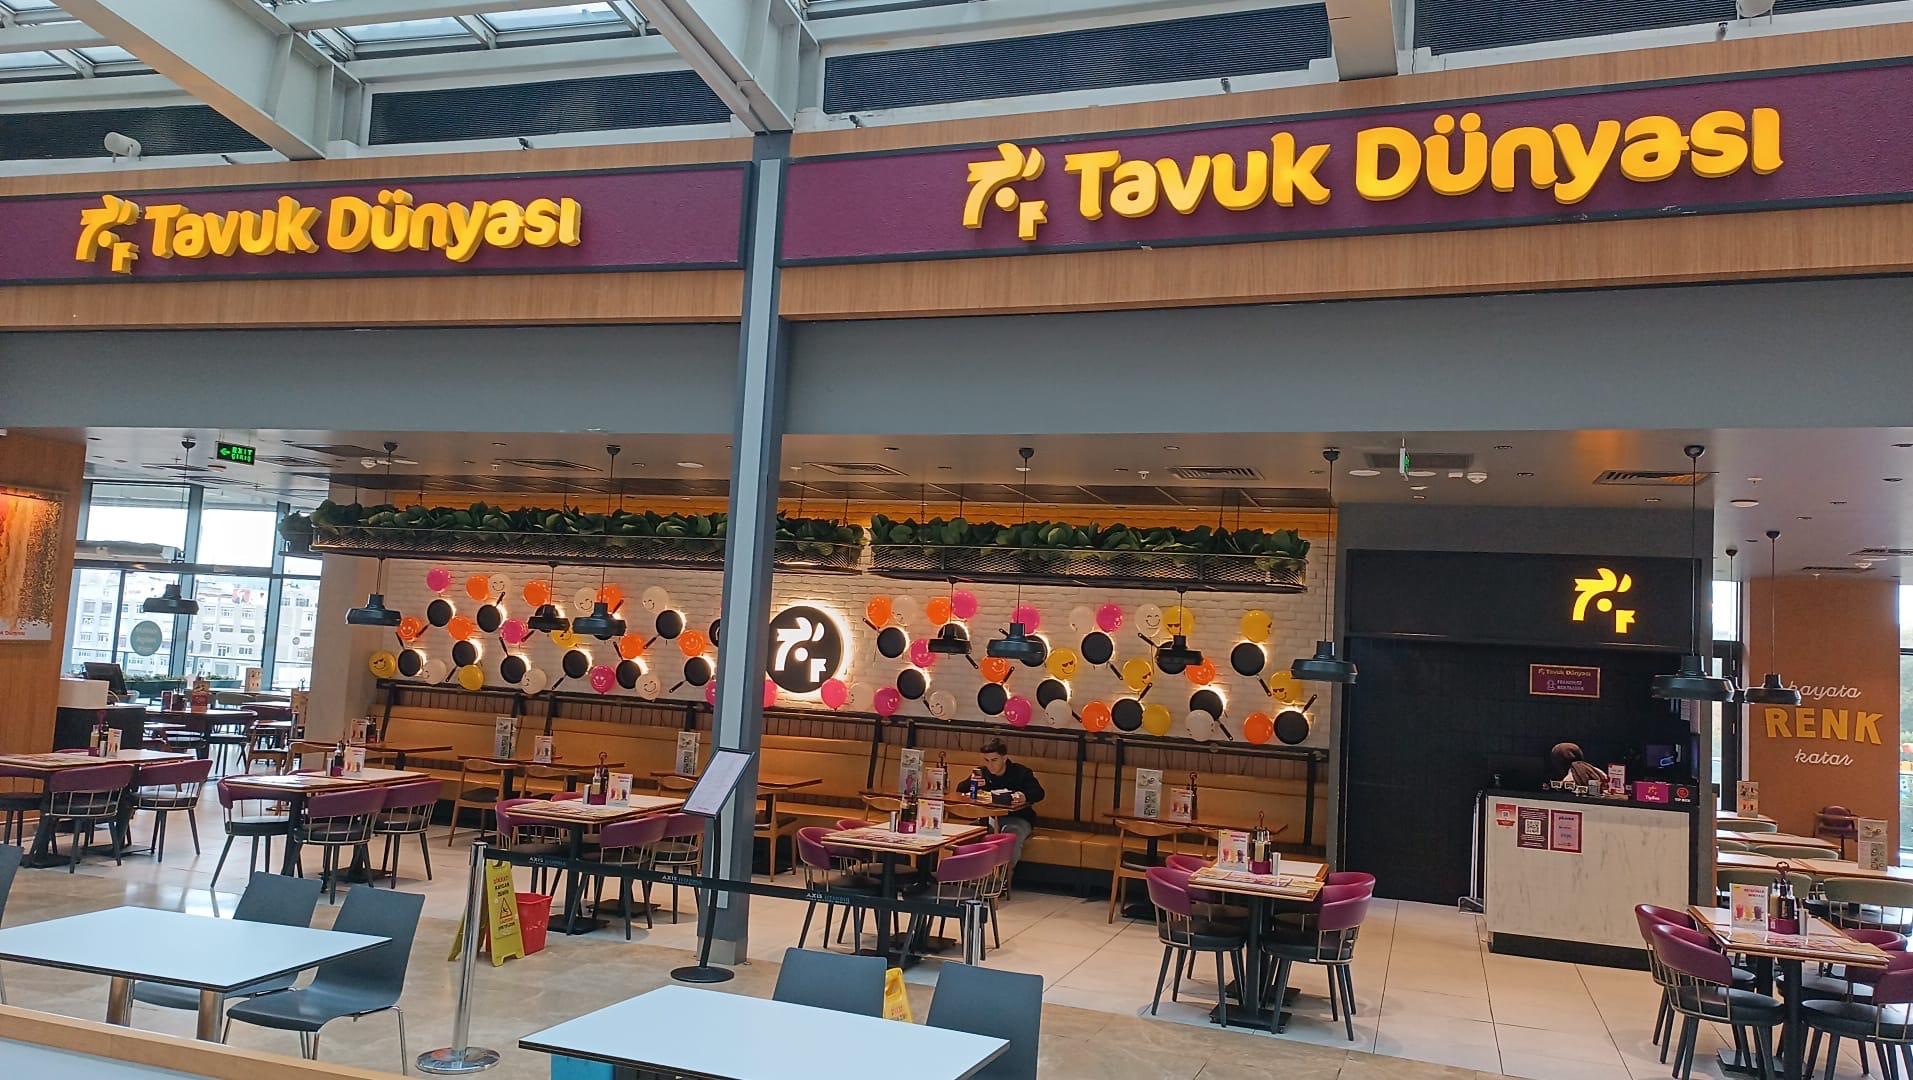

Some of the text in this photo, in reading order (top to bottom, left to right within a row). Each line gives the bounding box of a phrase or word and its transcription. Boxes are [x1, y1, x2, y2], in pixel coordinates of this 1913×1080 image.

[1064, 106, 1784, 222] Tavuk Dünyası
[144, 188, 581, 263] Tavuk Dünyası
[231, 446, 253, 456] EXIT
[1788, 680, 1862, 701] hayata
[1764, 707, 1884, 745] RENK
[1794, 748, 1854, 766] katar
